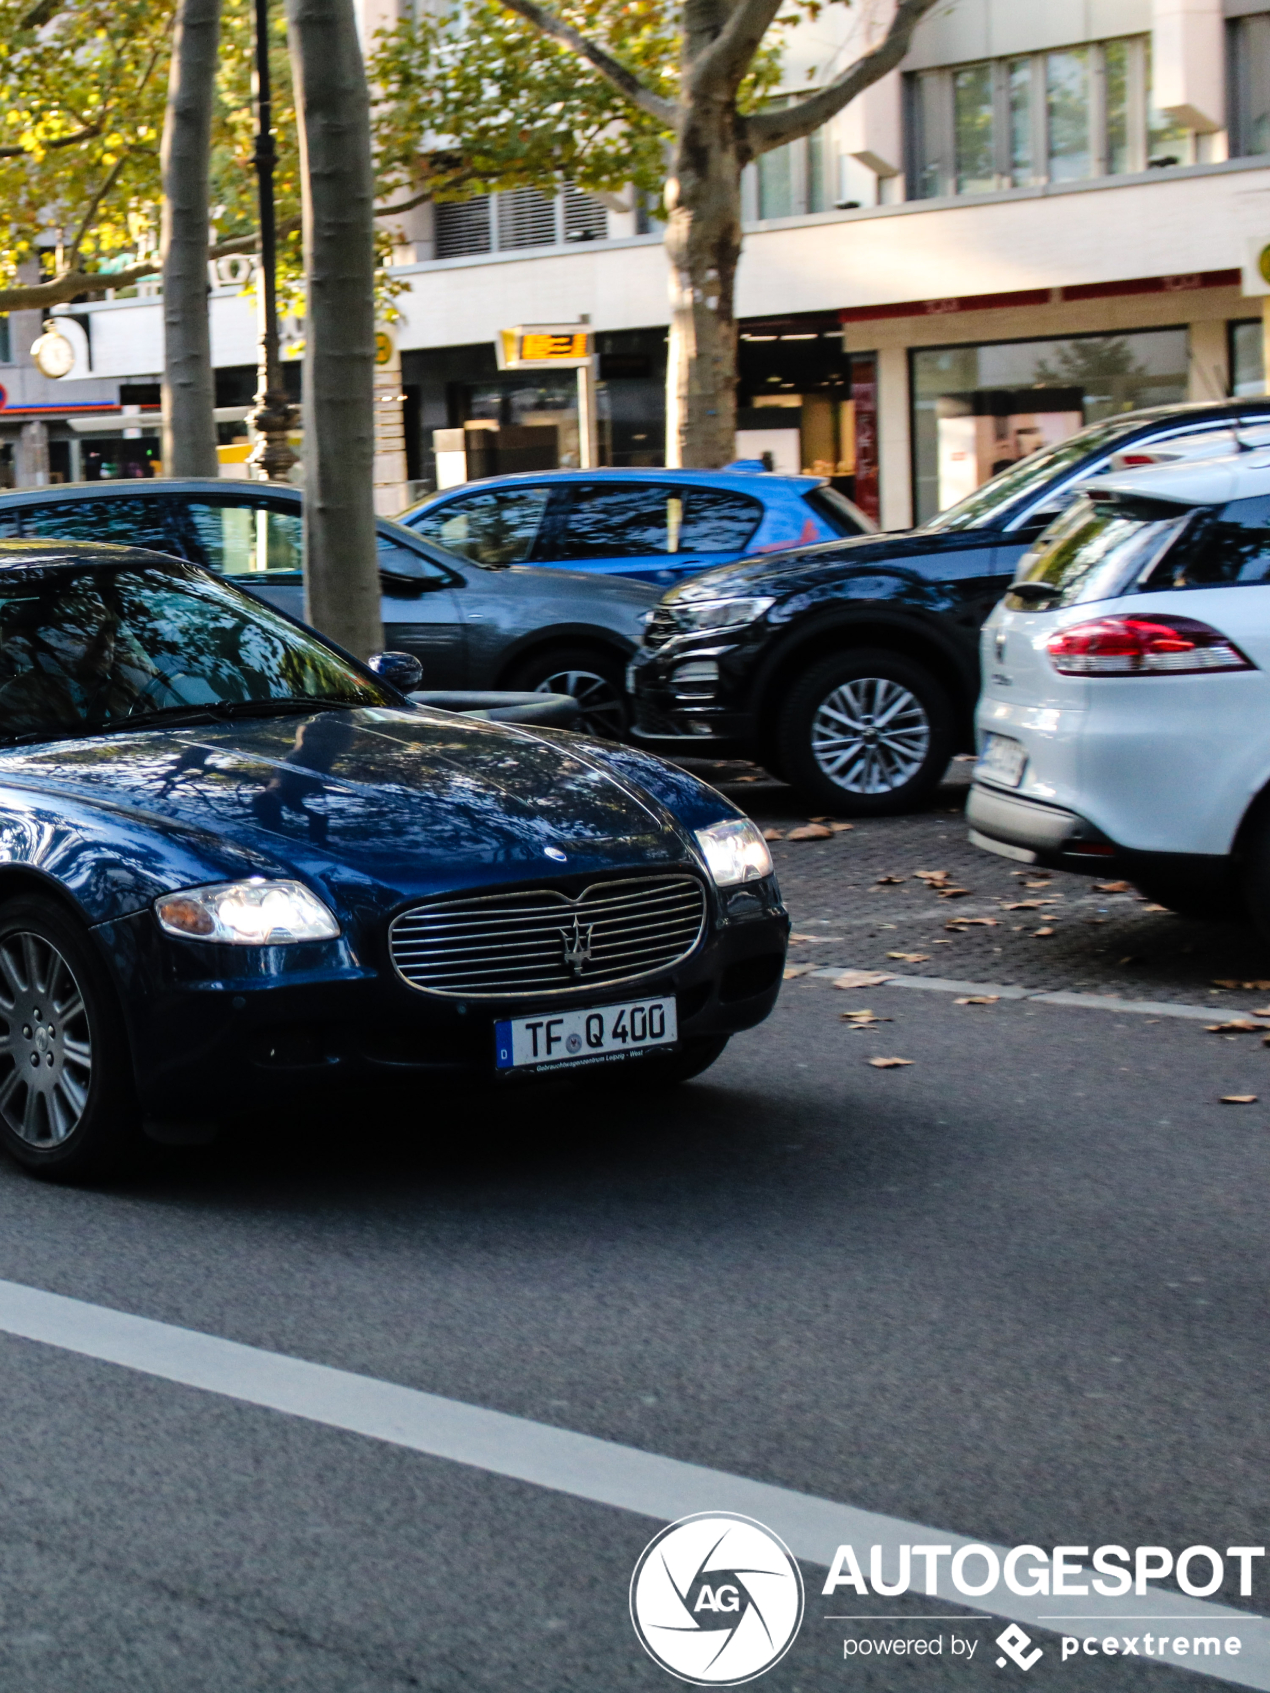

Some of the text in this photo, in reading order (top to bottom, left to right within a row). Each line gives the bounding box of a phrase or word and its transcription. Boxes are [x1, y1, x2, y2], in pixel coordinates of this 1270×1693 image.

[525, 1004, 665, 1057] TF Q 400
[501, 1049, 507, 1059] D
[536, 1056, 604, 1072] Gebrauchtwagenzentrum
[606, 1052, 625, 1063] Leipzig
[630, 1049, 644, 1058] West
